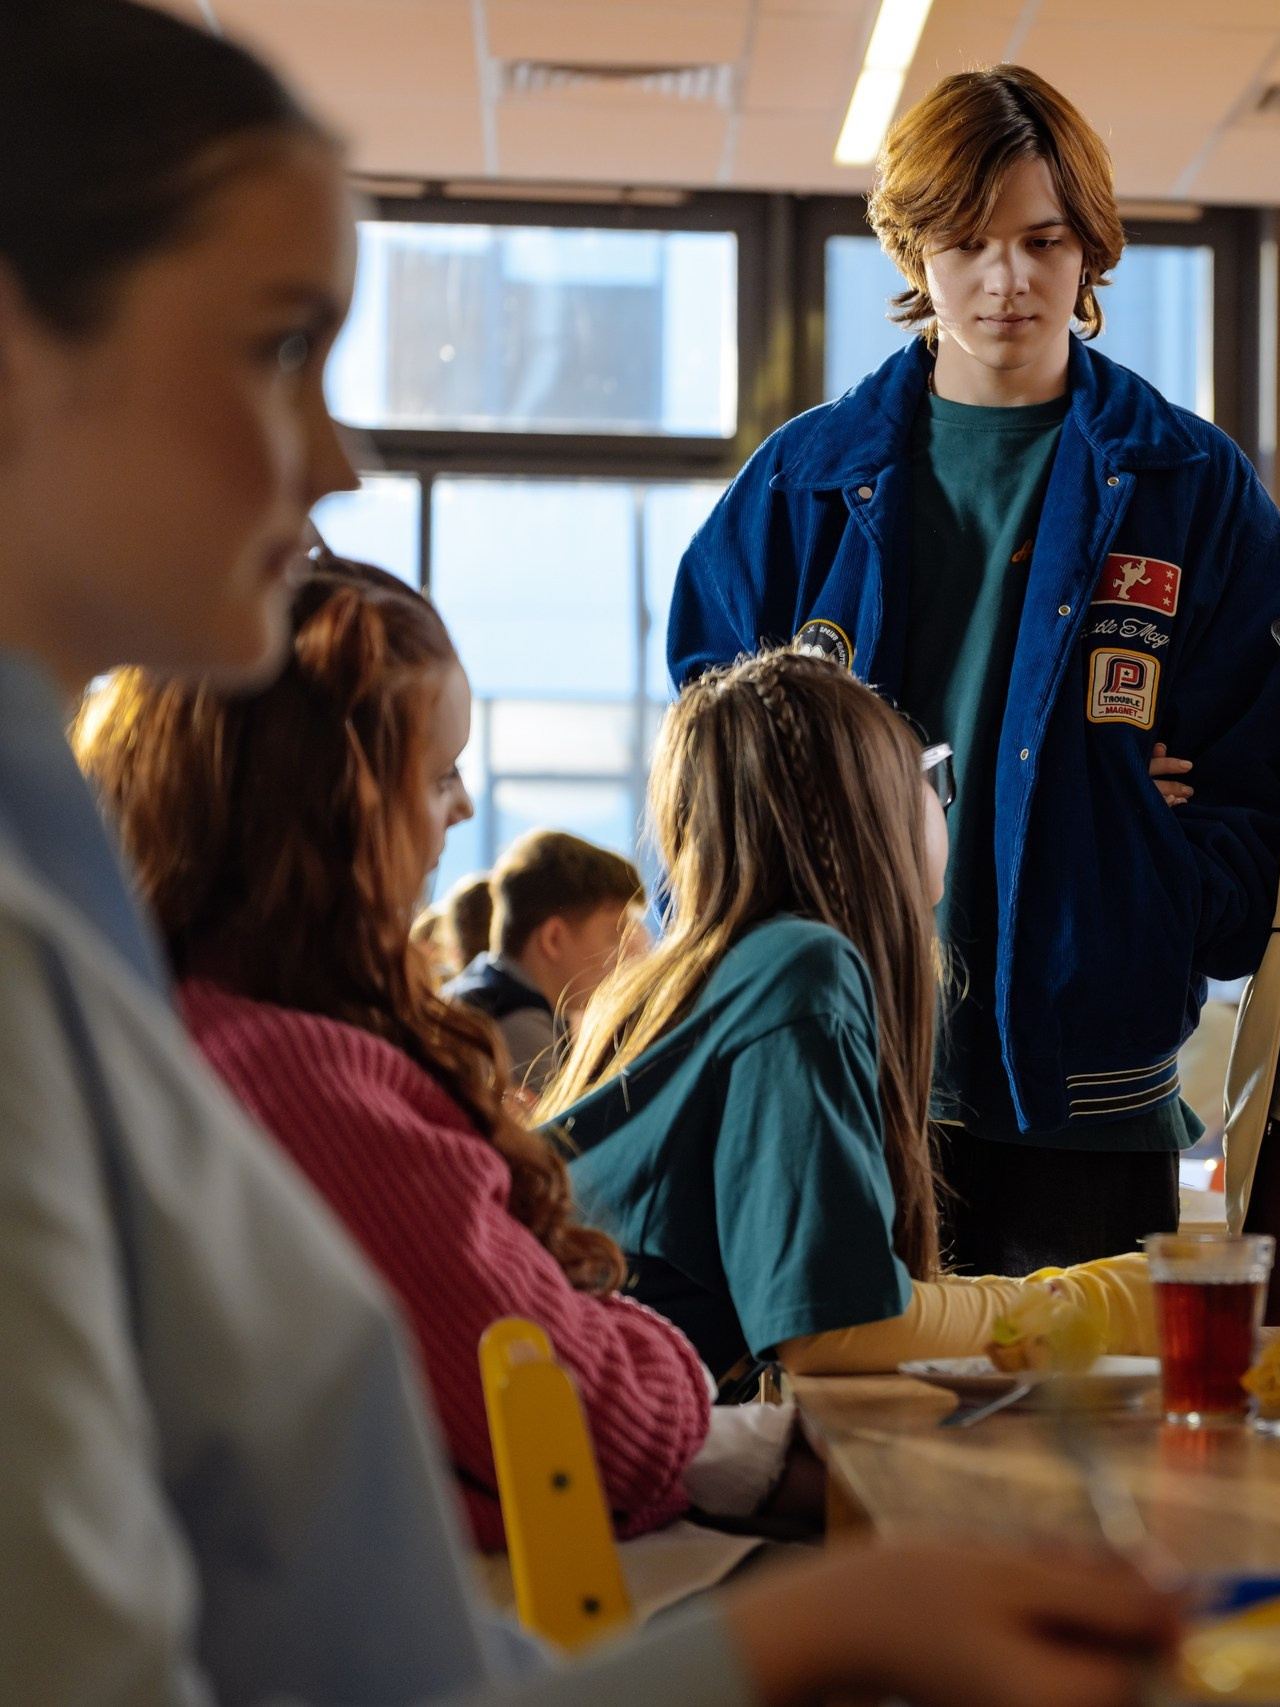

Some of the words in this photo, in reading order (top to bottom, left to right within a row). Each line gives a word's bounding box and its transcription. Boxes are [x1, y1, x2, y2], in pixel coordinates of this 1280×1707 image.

[1119, 617, 1170, 649] Mag
[1103, 695, 1141, 708] TROUBLE
[1105, 706, 1138, 717] MAGNET
